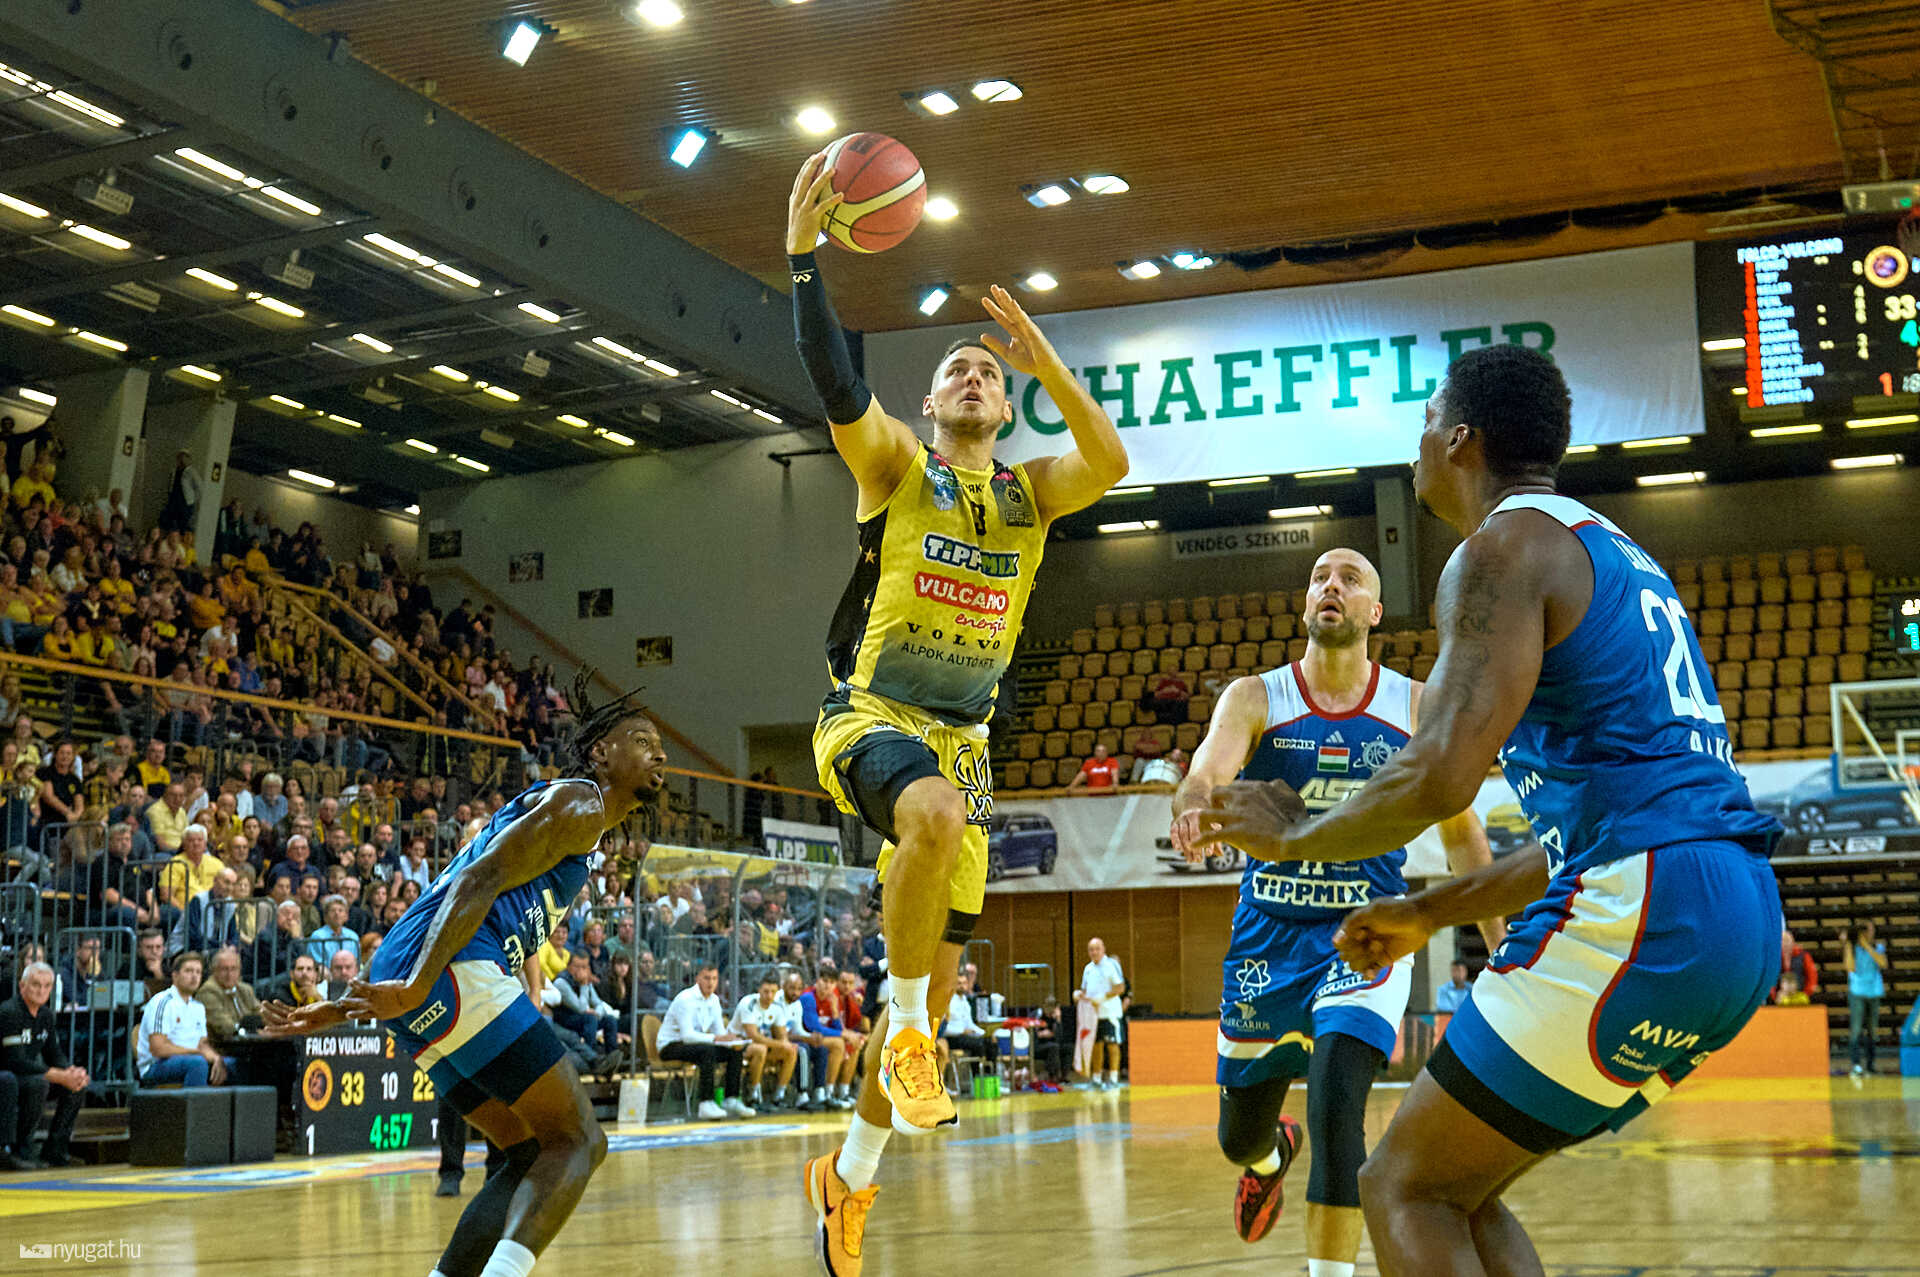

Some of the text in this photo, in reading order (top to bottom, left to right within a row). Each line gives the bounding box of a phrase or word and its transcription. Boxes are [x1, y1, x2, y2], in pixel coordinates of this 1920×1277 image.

[1884, 295, 1916, 320] 33
[1245, 529, 1310, 547] SZEKTOR
[918, 574, 1006, 611] VULCANO
[906, 621, 1001, 650] VOLVO
[901, 642, 944, 661] ALPOK
[305, 1036, 396, 1059] FALCO VULCANO 2
[340, 1069, 435, 1106] 33 10 22
[306, 1124, 316, 1155] 1
[369, 1112, 413, 1150] 4:57
